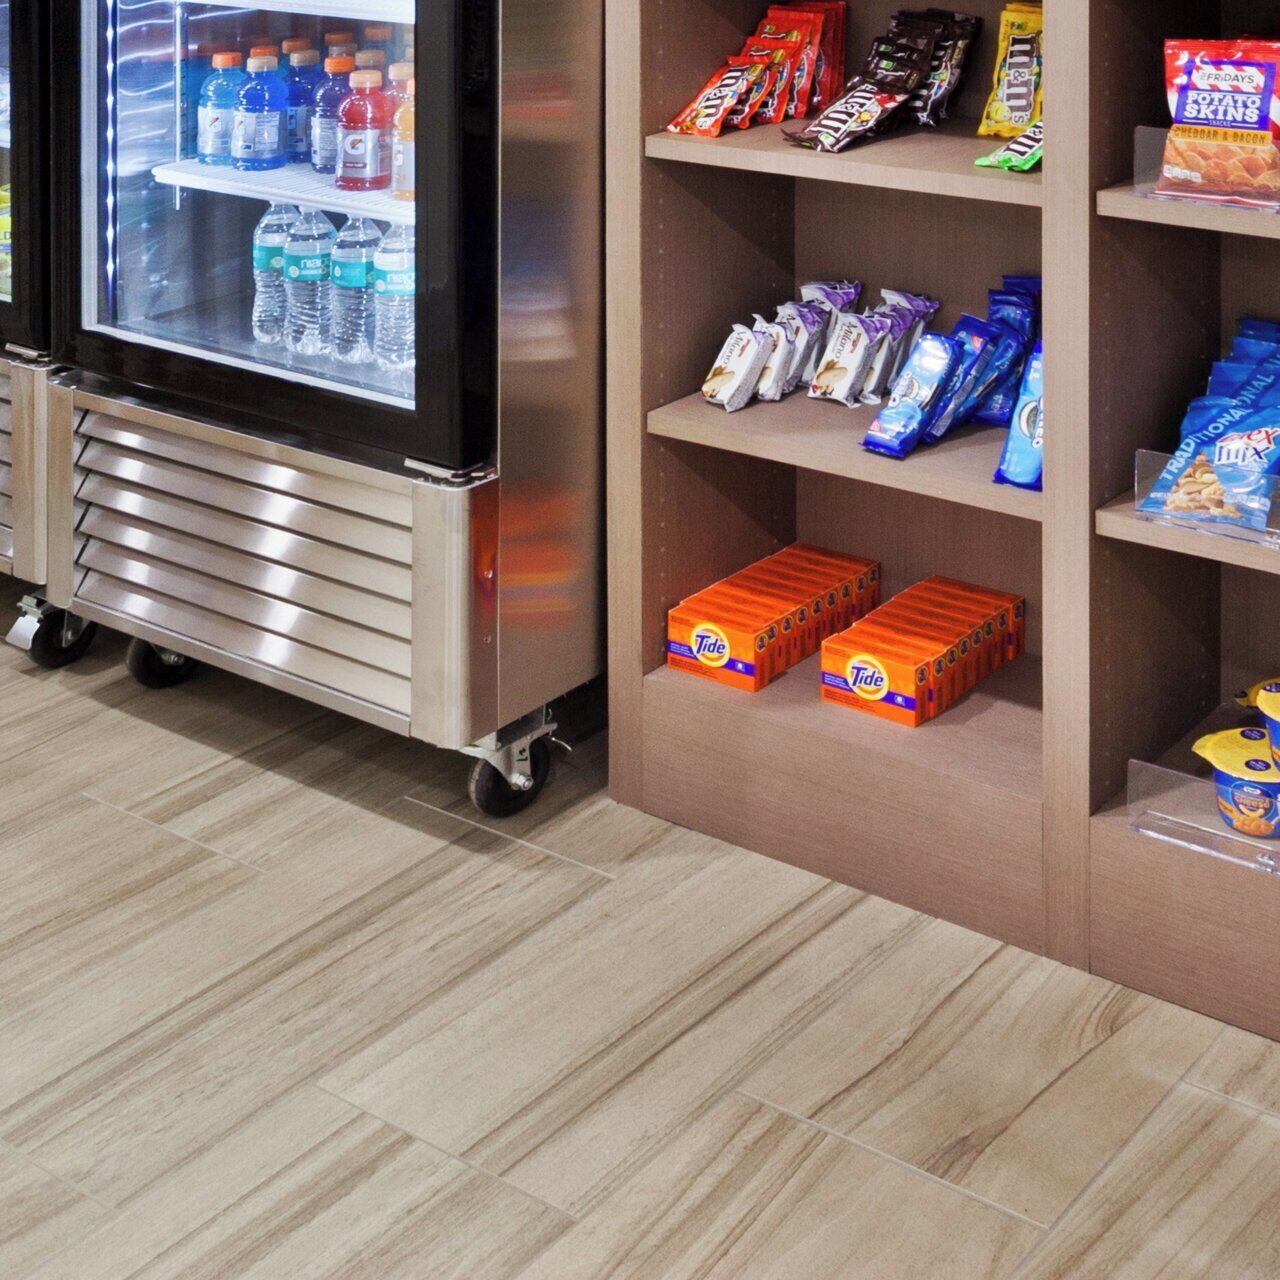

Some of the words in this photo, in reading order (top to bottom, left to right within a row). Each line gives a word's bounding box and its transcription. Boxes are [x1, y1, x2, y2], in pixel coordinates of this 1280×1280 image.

[1186, 92, 1261, 108] POTATO
[1183, 103, 1260, 123] SKINS
[1175, 127, 1218, 139] CHEDDAR
[1233, 132, 1266, 144] BACON
[1160, 407, 1254, 481] TRADITIONAL
[695, 634, 726, 655] Tide
[851, 666, 885, 687] Tide
